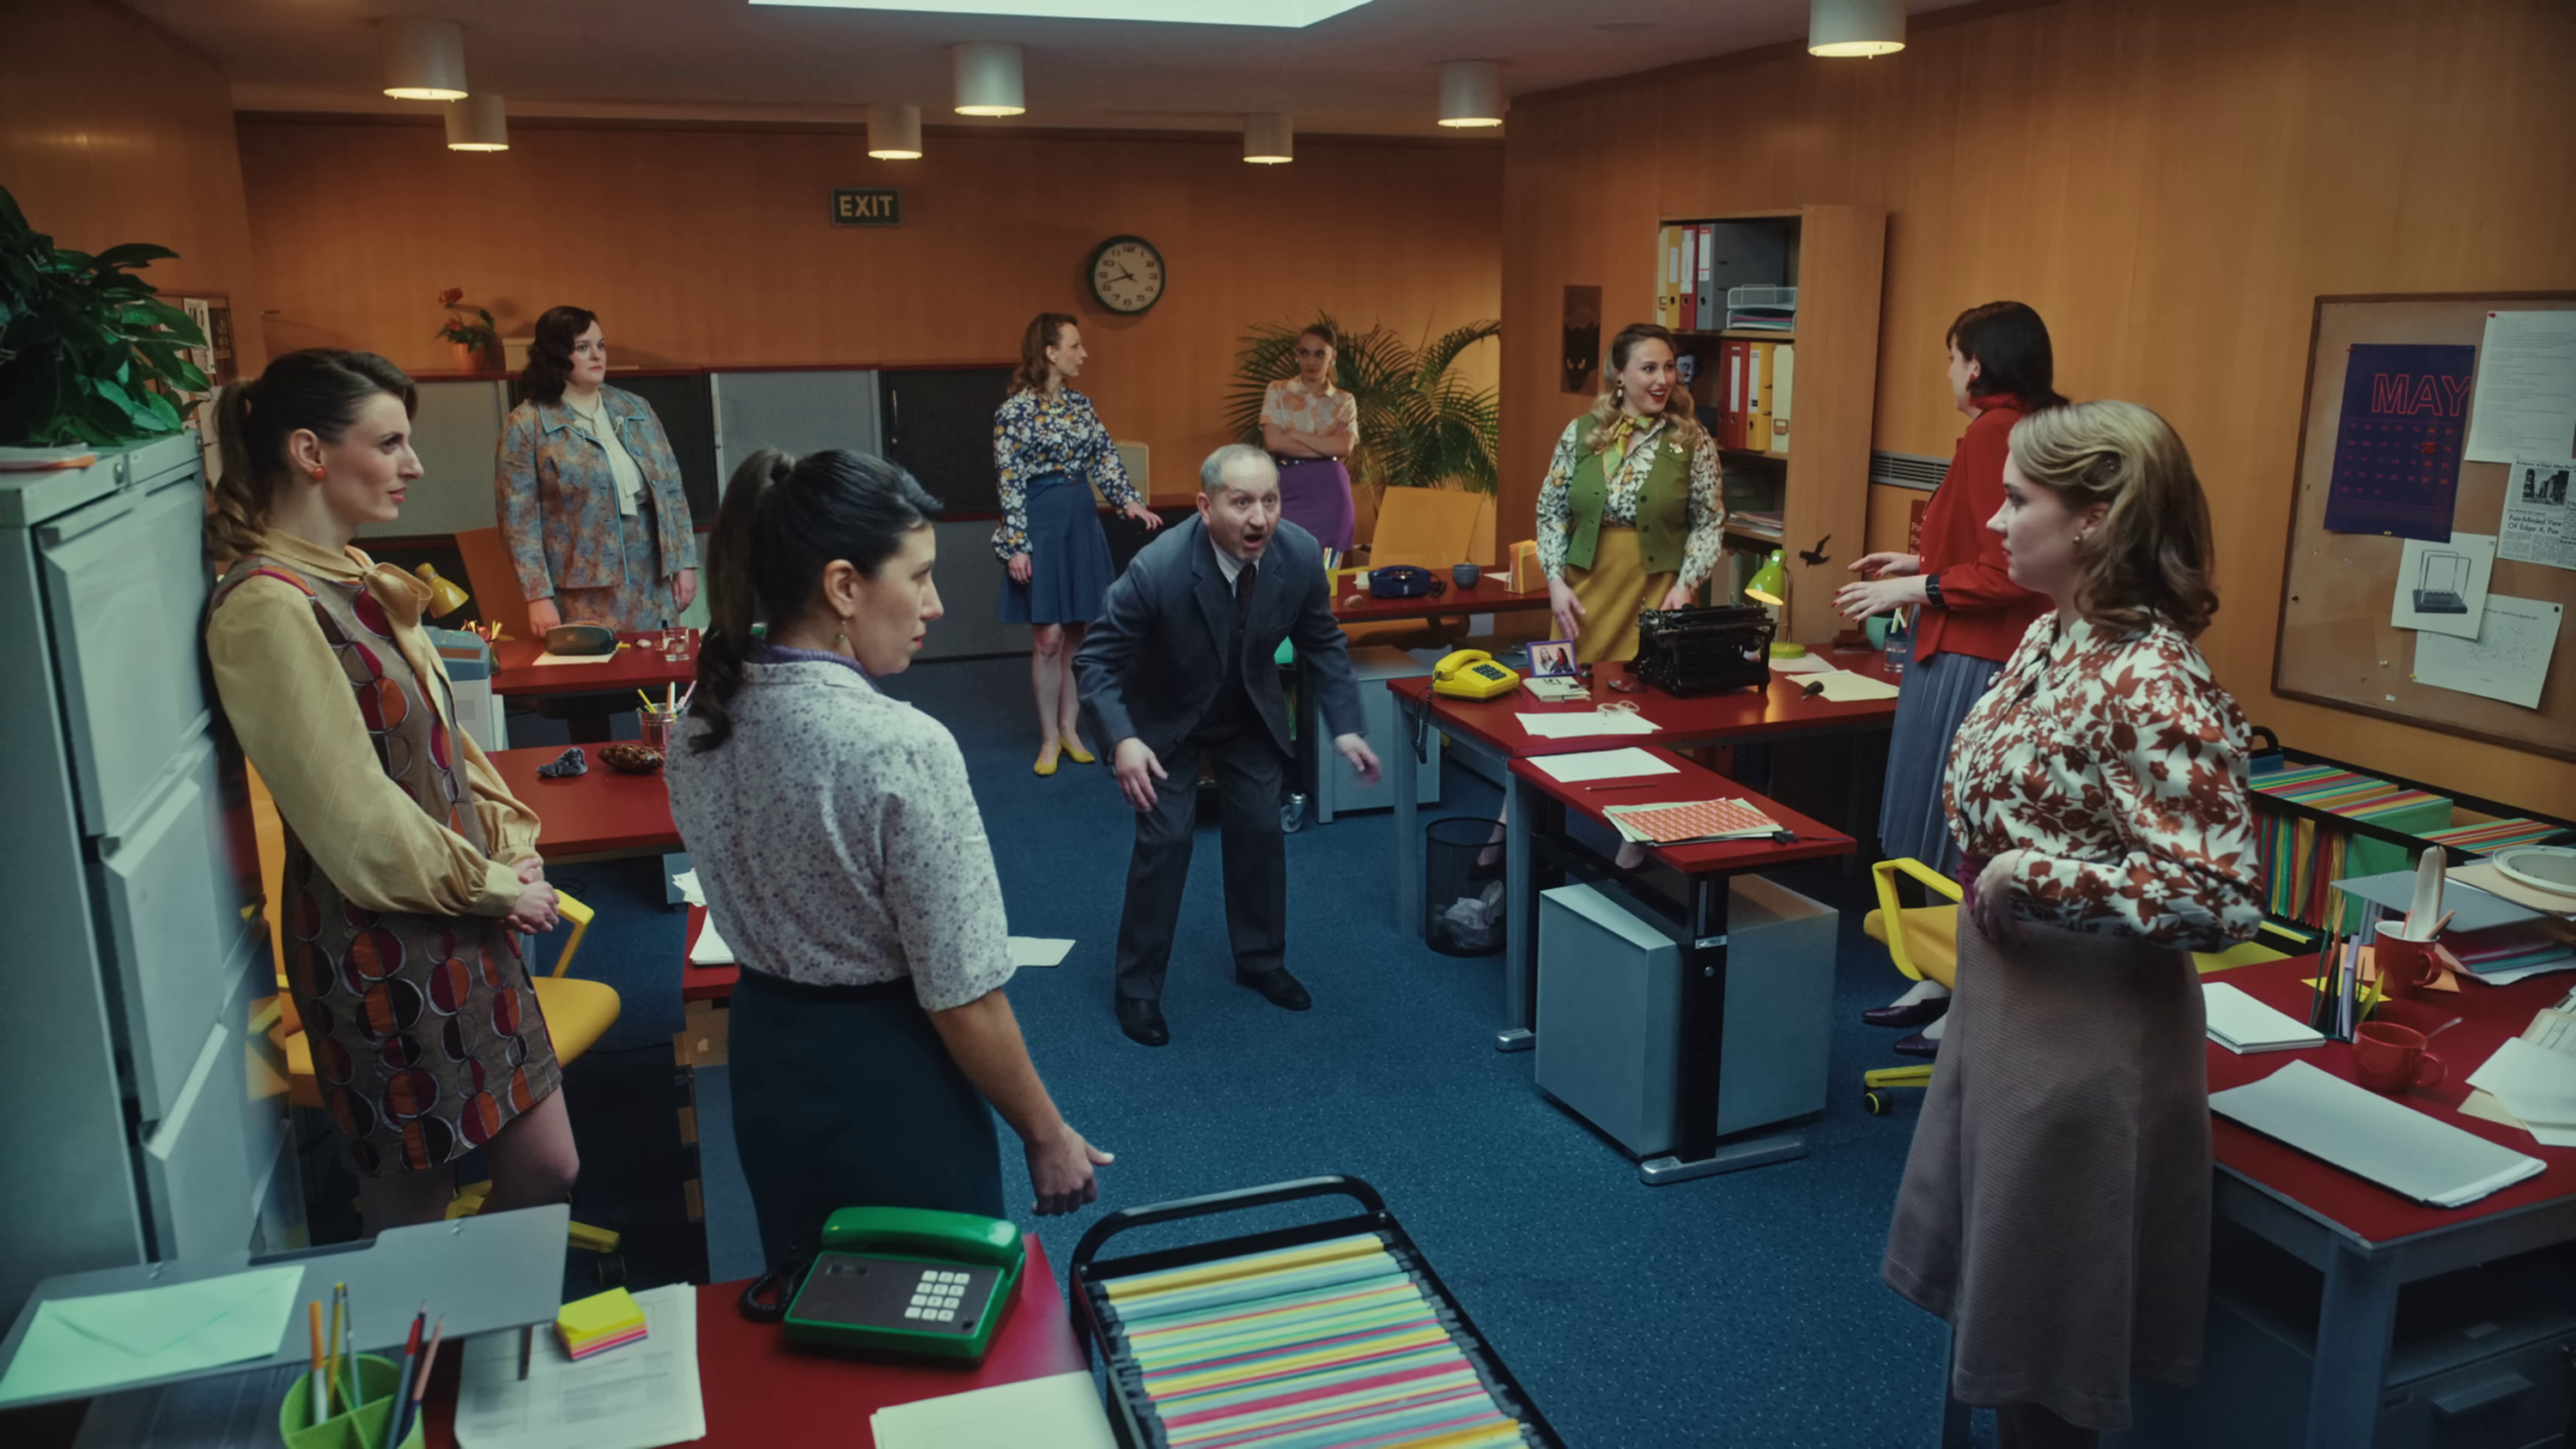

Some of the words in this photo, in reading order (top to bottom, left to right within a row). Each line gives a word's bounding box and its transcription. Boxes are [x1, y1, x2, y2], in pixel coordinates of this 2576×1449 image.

[839, 195, 893, 217] EXIT
[2372, 373, 2471, 417] MAY
[2508, 514, 2546, 524] Fair-Minded
[2518, 523, 2537, 532] Edgar
